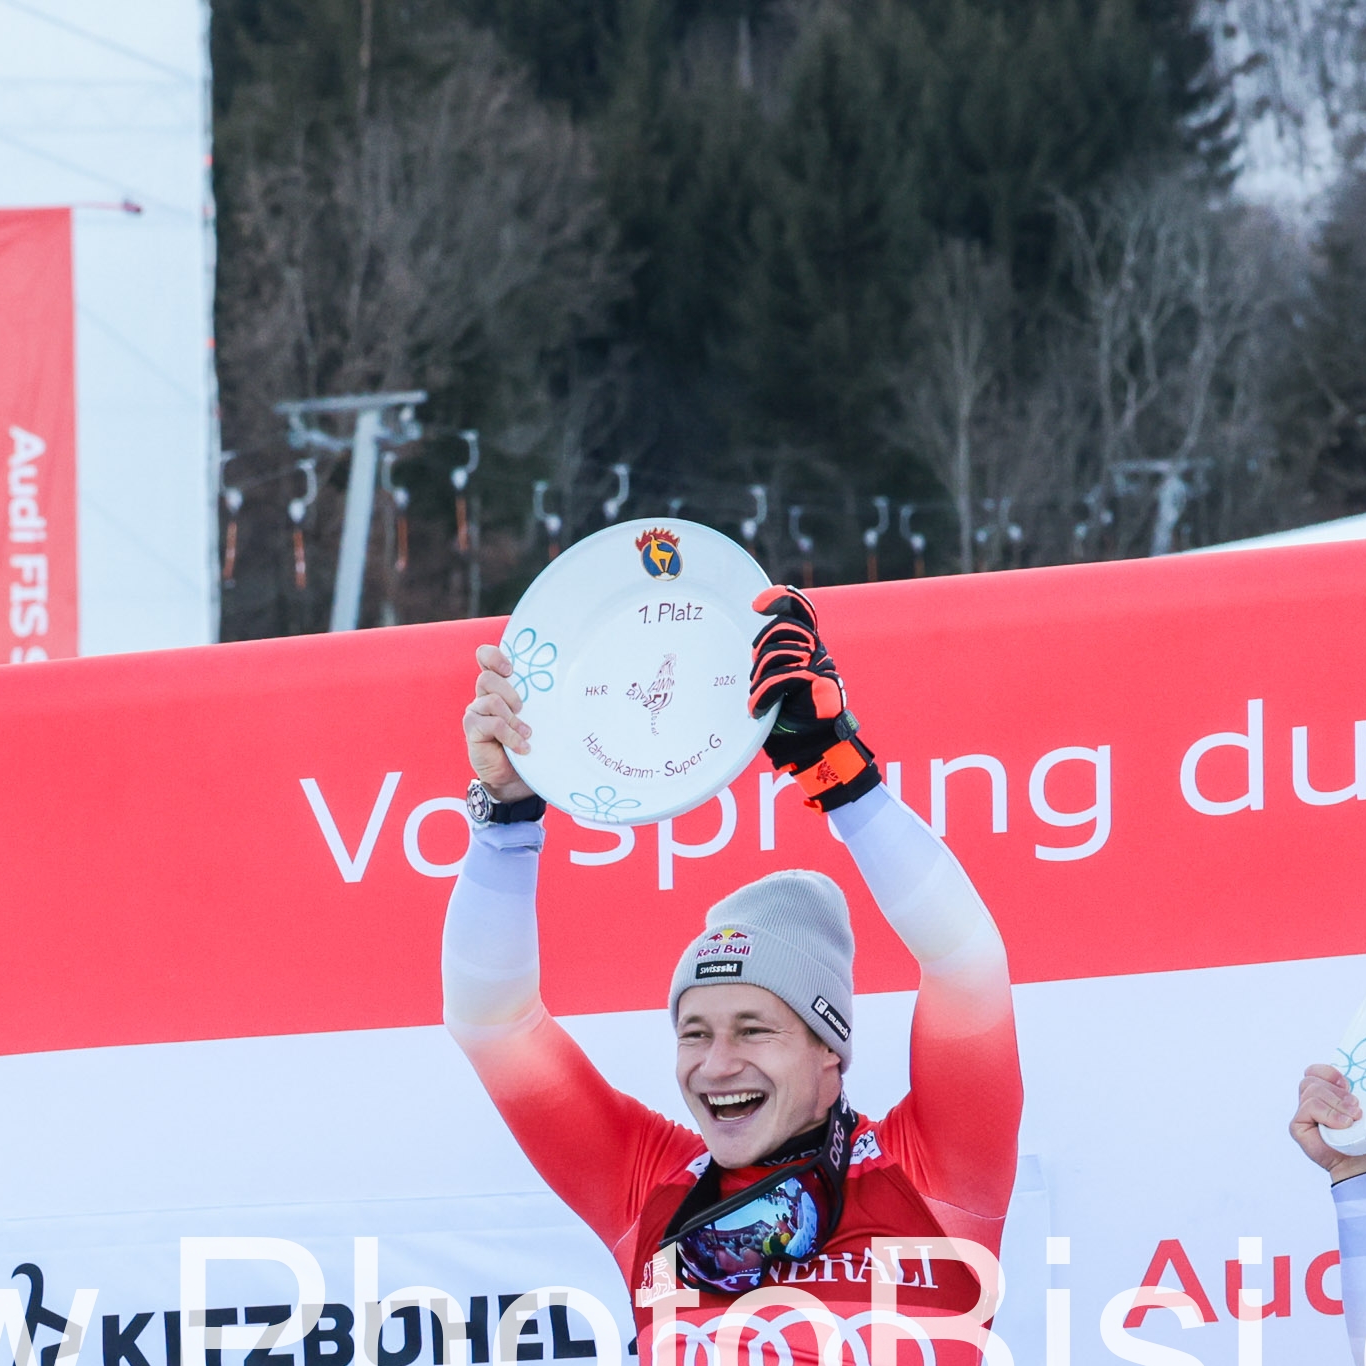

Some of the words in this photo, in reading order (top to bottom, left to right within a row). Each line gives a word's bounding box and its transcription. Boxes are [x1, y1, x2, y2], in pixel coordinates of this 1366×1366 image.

[9, 427, 46, 543] Audi
[11, 555, 47, 636] FIS
[638, 604, 652, 624] 1.
[658, 602, 703, 623] Platz
[713, 674, 737, 687] 2026
[585, 684, 608, 696] HKR
[697, 945, 721, 959] Red
[724, 944, 750, 956] Bull
[699, 963, 738, 976] swissski
[823, 1008, 851, 1039] reusch
